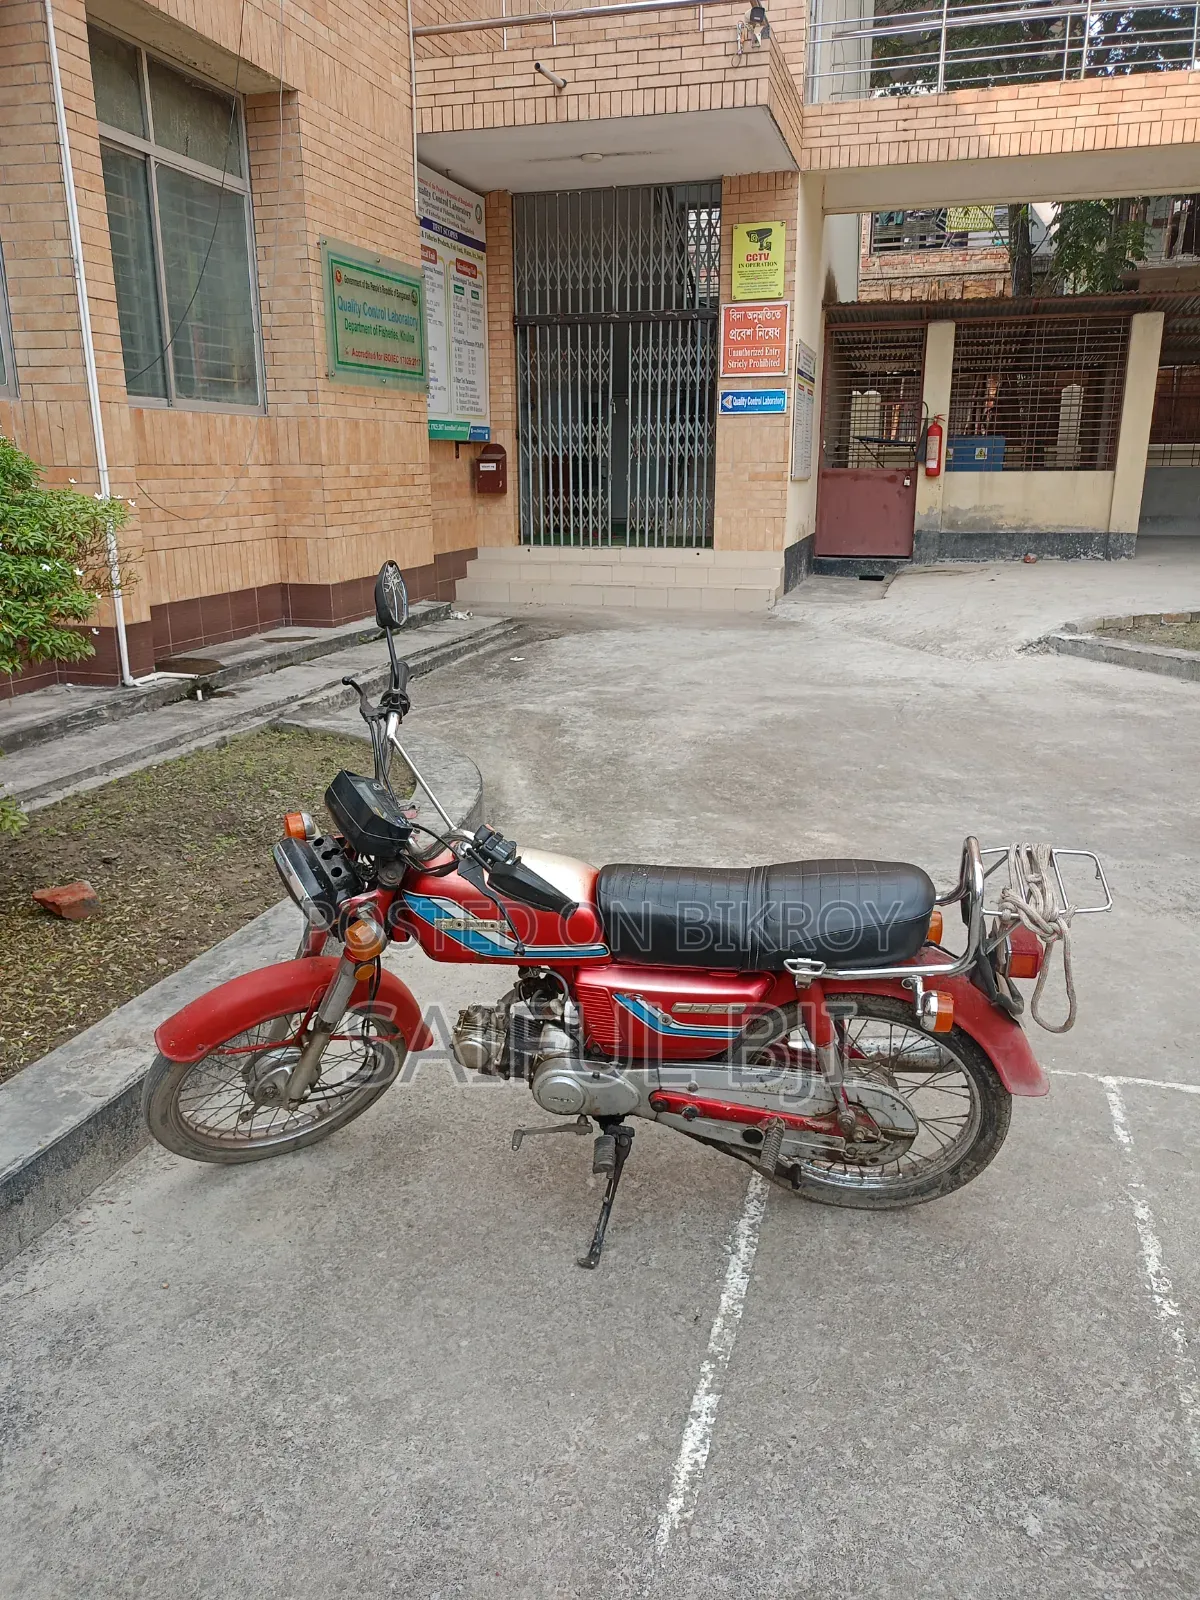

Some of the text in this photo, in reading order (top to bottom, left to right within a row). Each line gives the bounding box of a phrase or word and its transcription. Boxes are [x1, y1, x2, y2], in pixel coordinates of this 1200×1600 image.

[418, 186, 431, 200] uality
[746, 253, 770, 262] CCTV
[344, 274, 361, 287] Government
[337, 295, 361, 318] Quality
[363, 302, 386, 320] Control
[388, 308, 418, 331] Laboratory
[729, 307, 782, 323] বিনা অনুমতিতে
[345, 318, 372, 335] Department
[373, 325, 378, 336] of
[729, 324, 781, 341] প্রবেশ নিষেধ
[728, 347, 781, 358] Unauthorized Entry
[749, 359, 781, 369] Prohibited
[733, 396, 784, 407] Quality Control Laboratory
